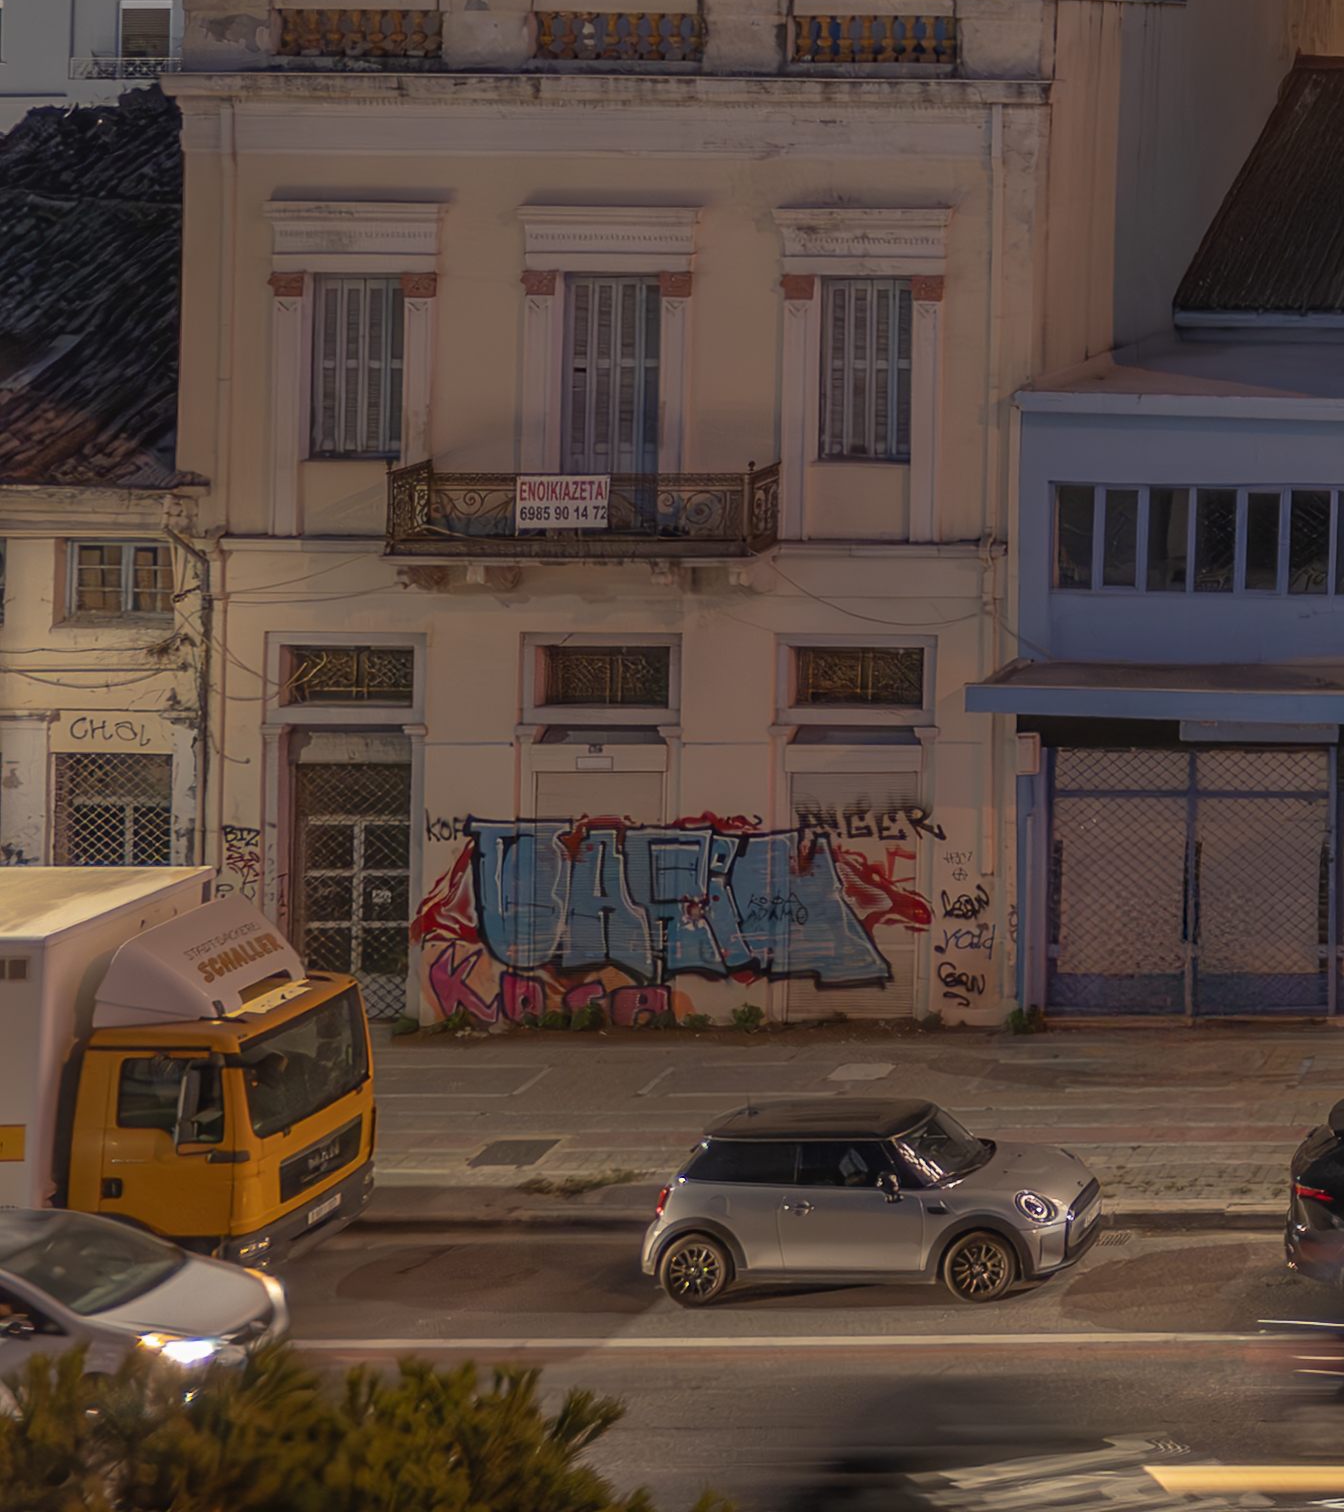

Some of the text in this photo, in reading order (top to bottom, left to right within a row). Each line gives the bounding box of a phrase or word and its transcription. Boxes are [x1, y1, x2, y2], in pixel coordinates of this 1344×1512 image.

[520, 480, 608, 501] ΕΝΟΙΚΙΑΖΕΤΑΙ
[520, 505, 608, 521] 6985 90 14 72
[197, 933, 284, 983] SCHALLER
